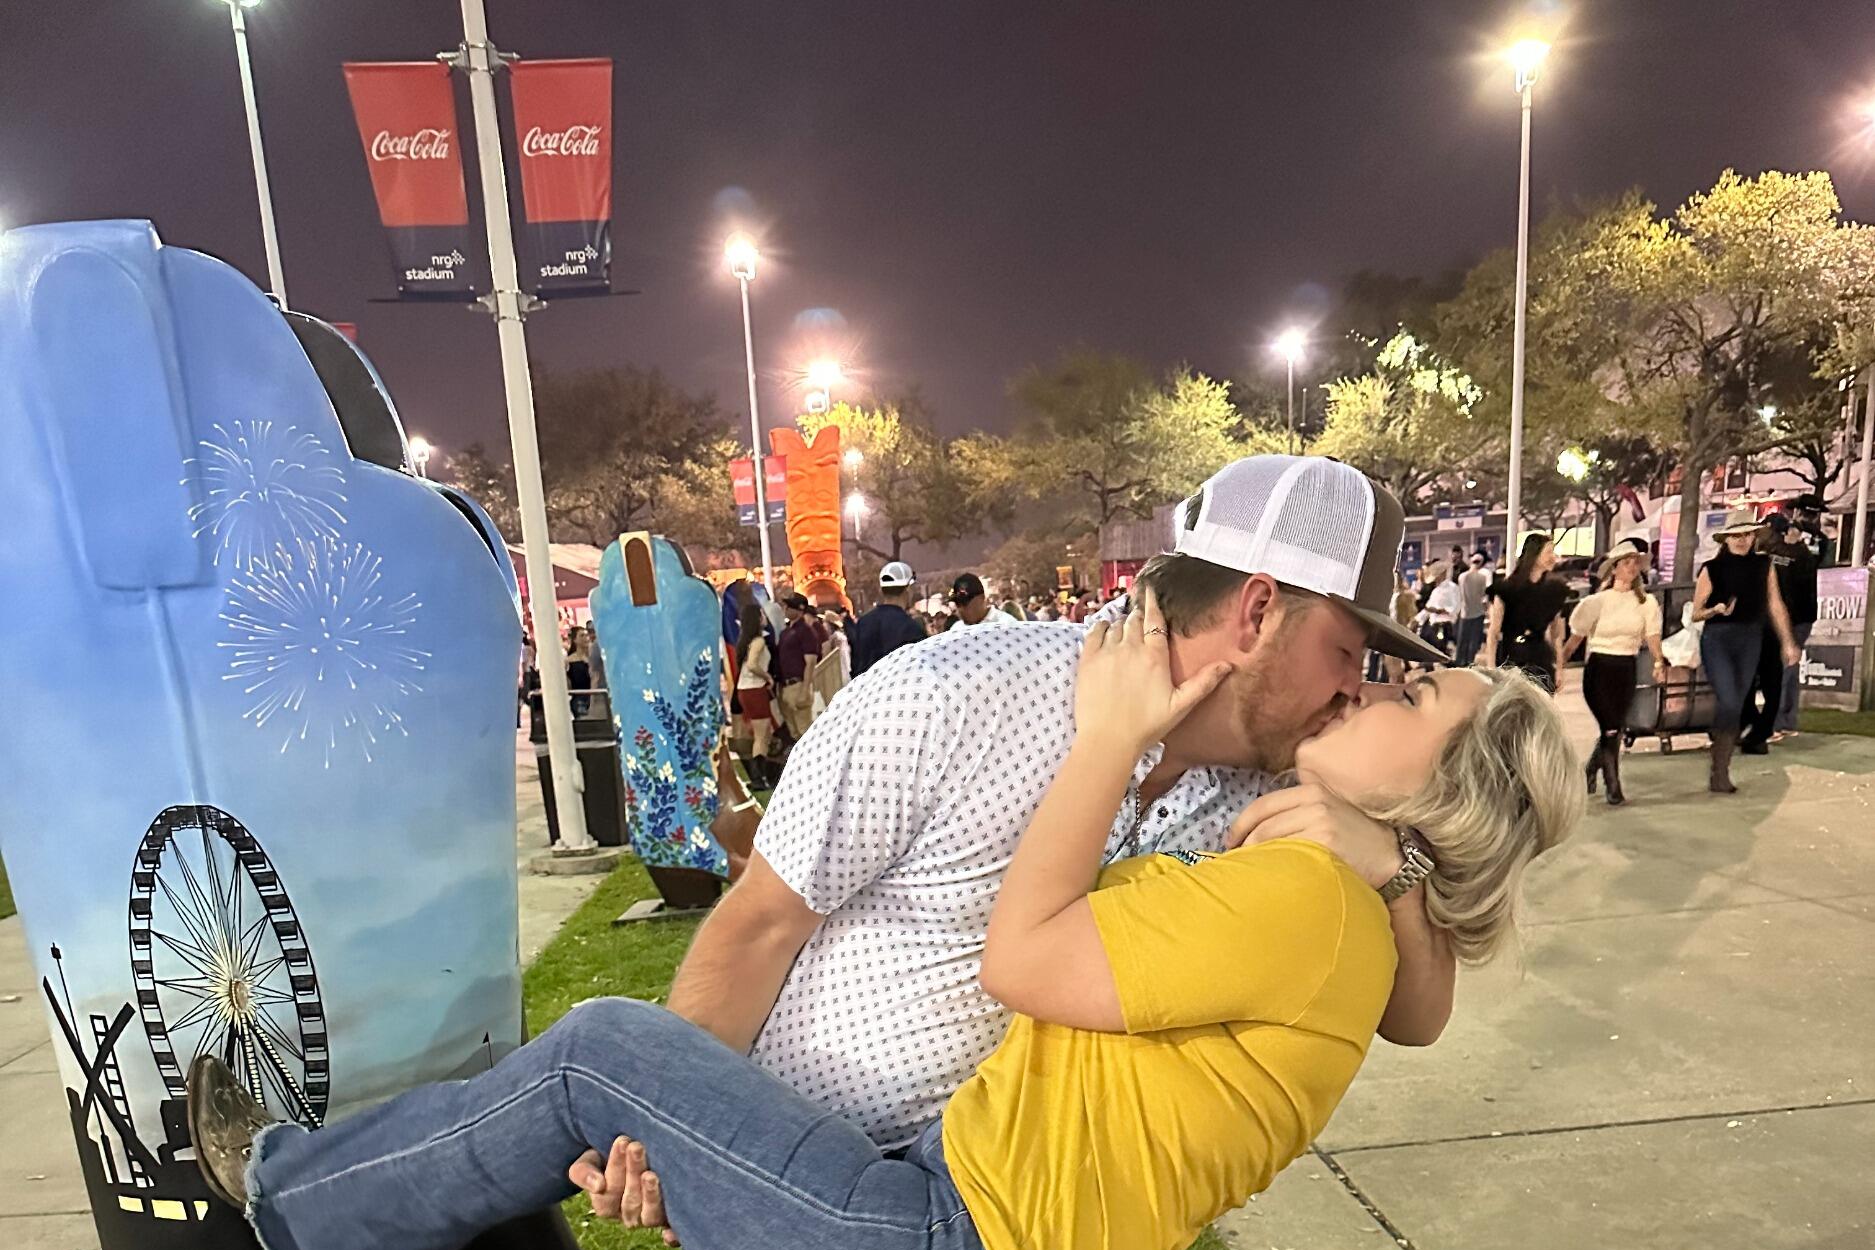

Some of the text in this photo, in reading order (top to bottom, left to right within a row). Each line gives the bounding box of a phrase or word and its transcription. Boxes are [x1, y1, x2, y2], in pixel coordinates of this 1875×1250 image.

[371, 129, 452, 162] Coca-Cola
[523, 125, 602, 157] Coca-Cola
[431, 254, 454, 269] nrg
[565, 250, 586, 264] nrg
[405, 266, 454, 280] stadium
[540, 263, 588, 277] stadium
[1826, 596, 1862, 620] ROW
